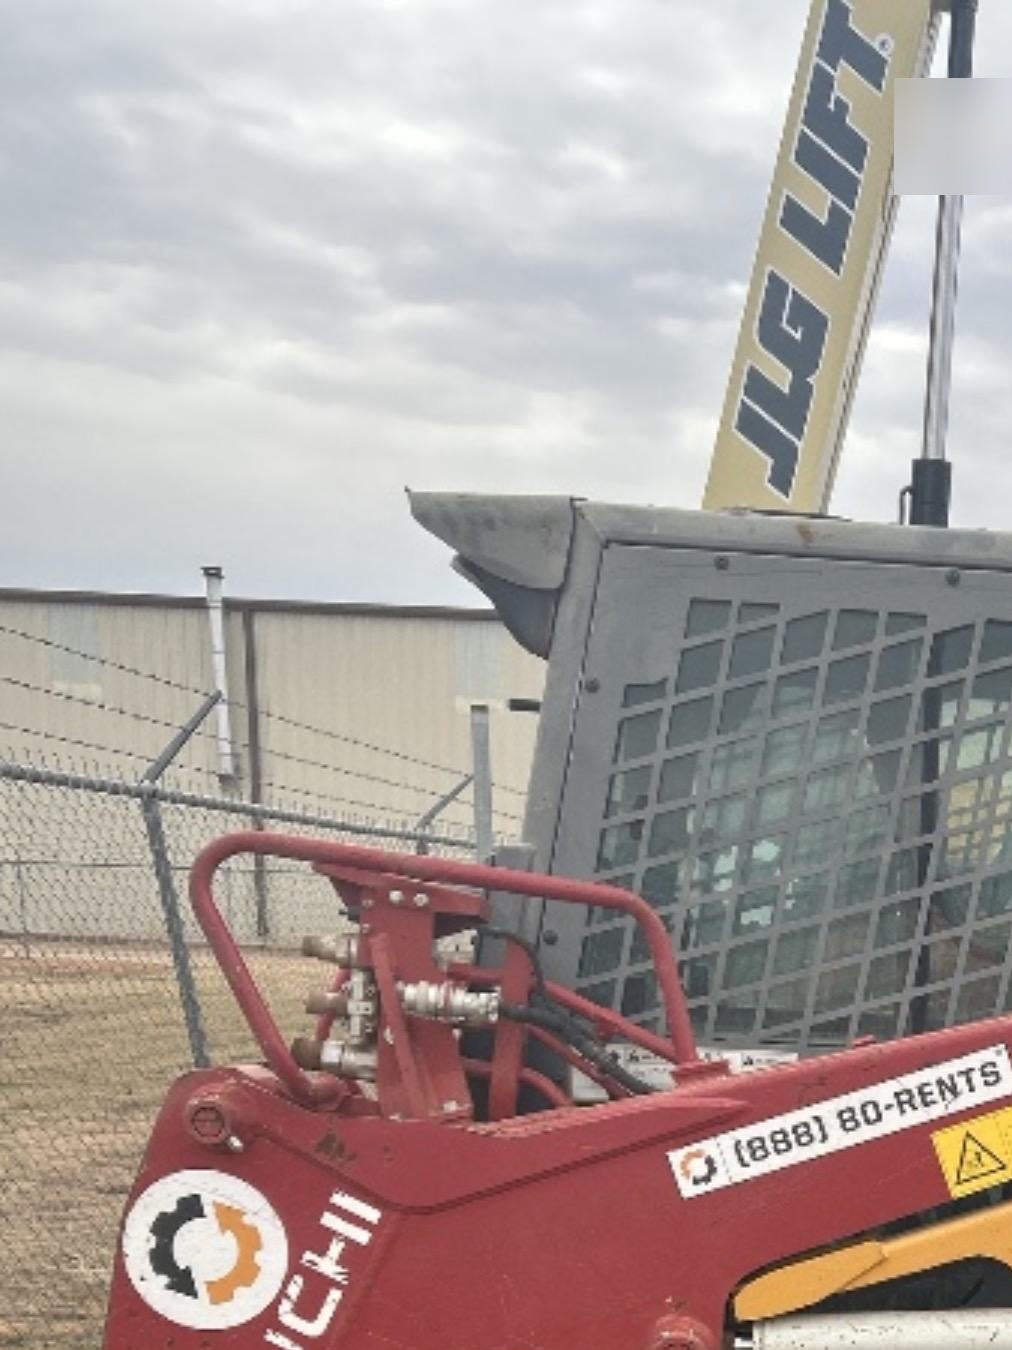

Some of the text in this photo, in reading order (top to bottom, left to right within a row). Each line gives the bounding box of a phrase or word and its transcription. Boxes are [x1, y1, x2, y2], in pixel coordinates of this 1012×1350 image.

[733, 267, 831, 500] JLG
[733, 1060, 1002, 1168] (888) 80-RENTS
